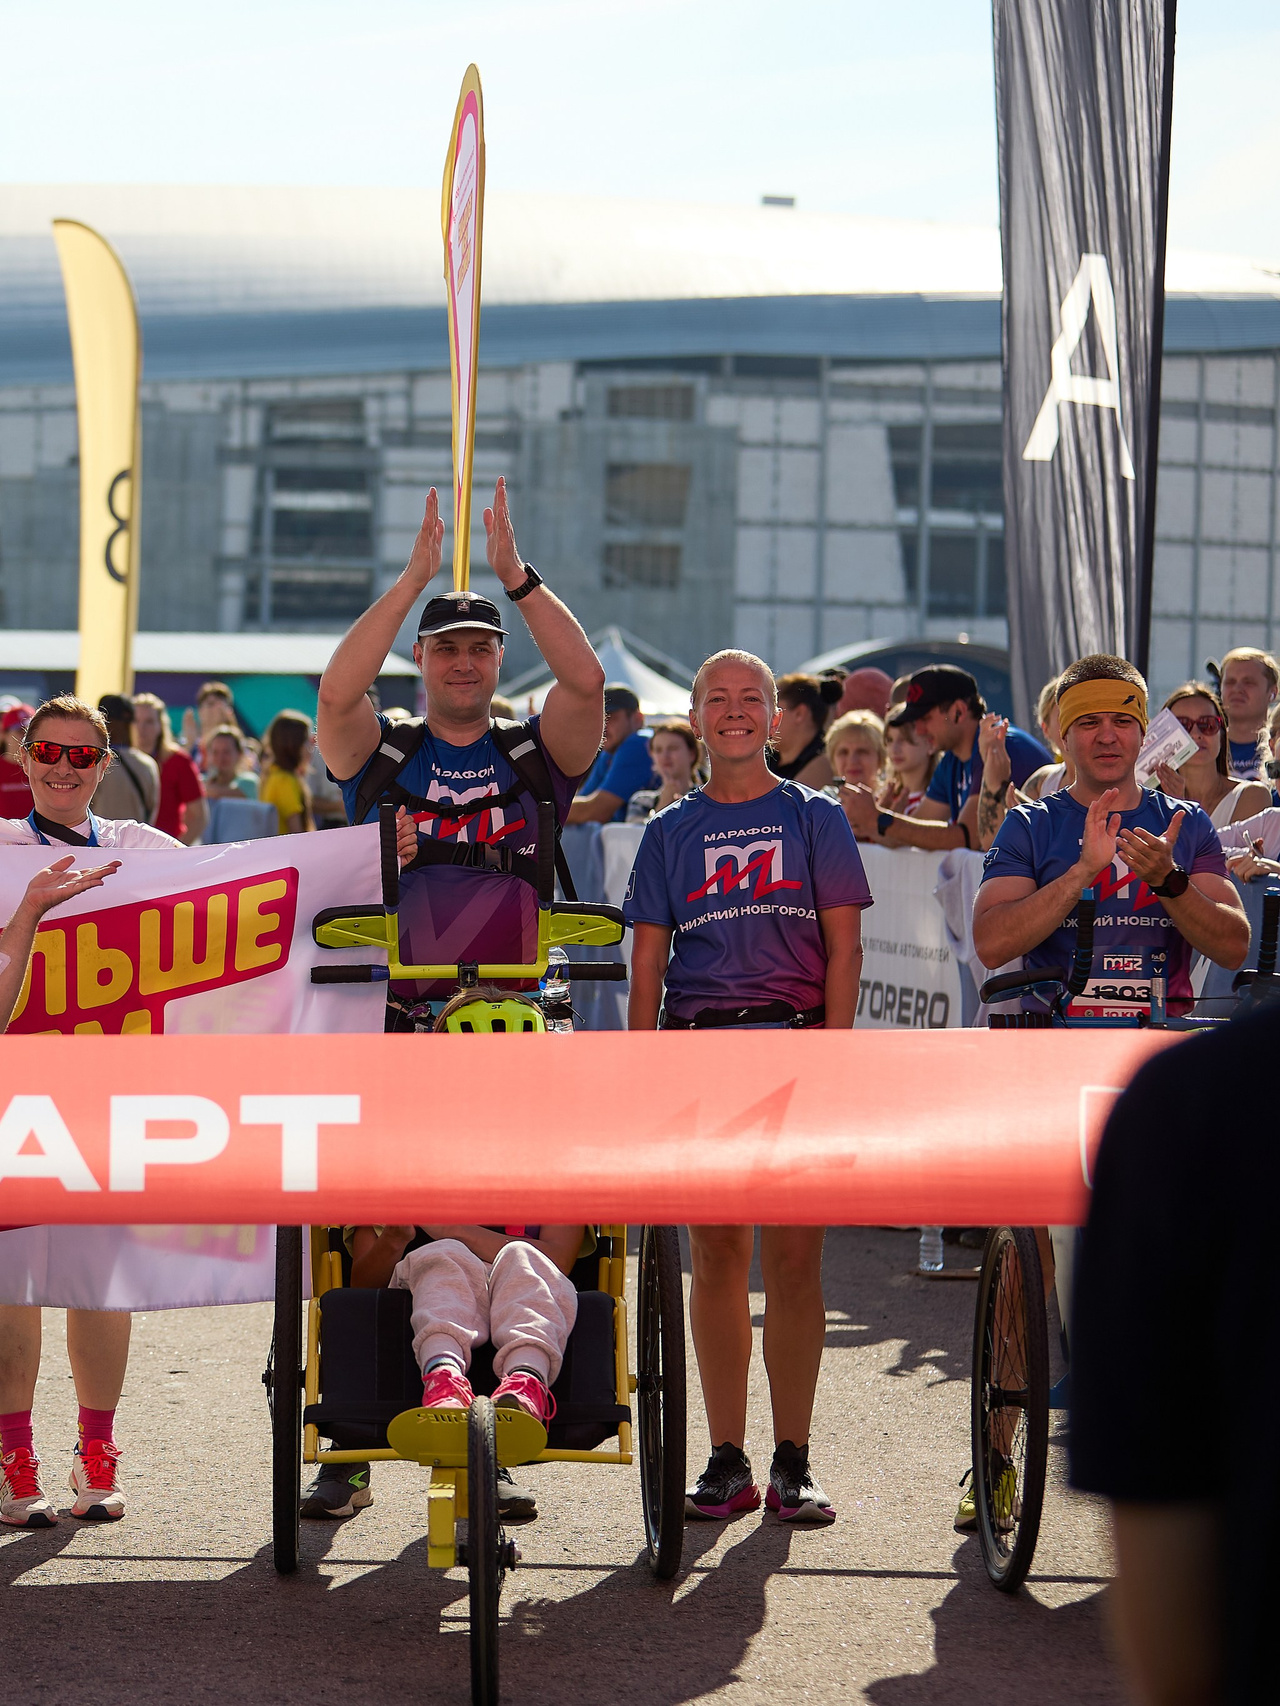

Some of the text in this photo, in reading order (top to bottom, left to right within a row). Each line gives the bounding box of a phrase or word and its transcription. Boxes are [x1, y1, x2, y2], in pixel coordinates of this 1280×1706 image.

[704, 825, 783, 843] МАРАФОН
[679, 905, 817, 933] НИЖНИЙ НОВГОРОД
[1117, 916, 1176, 928] НОВГОР
